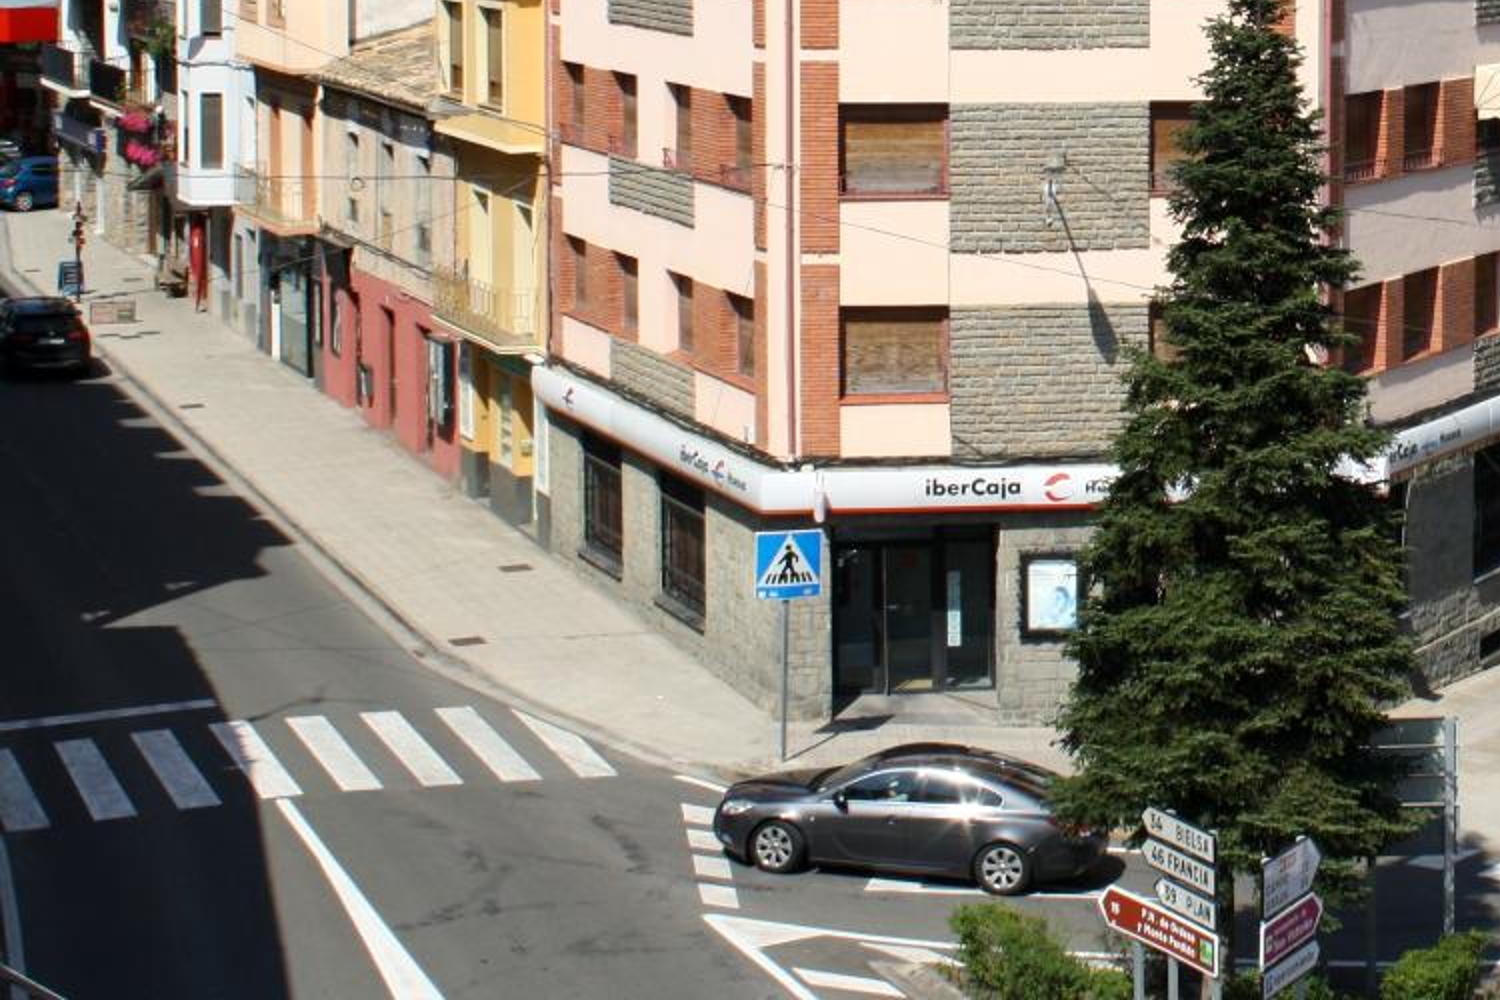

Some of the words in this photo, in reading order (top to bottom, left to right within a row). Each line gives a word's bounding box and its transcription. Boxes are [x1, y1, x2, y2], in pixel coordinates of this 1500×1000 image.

[925, 478, 1021, 499] iberCaja
[1175, 824, 1209, 854] BIELSA
[1167, 853, 1209, 888] FRANCIA
[1185, 895, 1212, 923] PLAN
